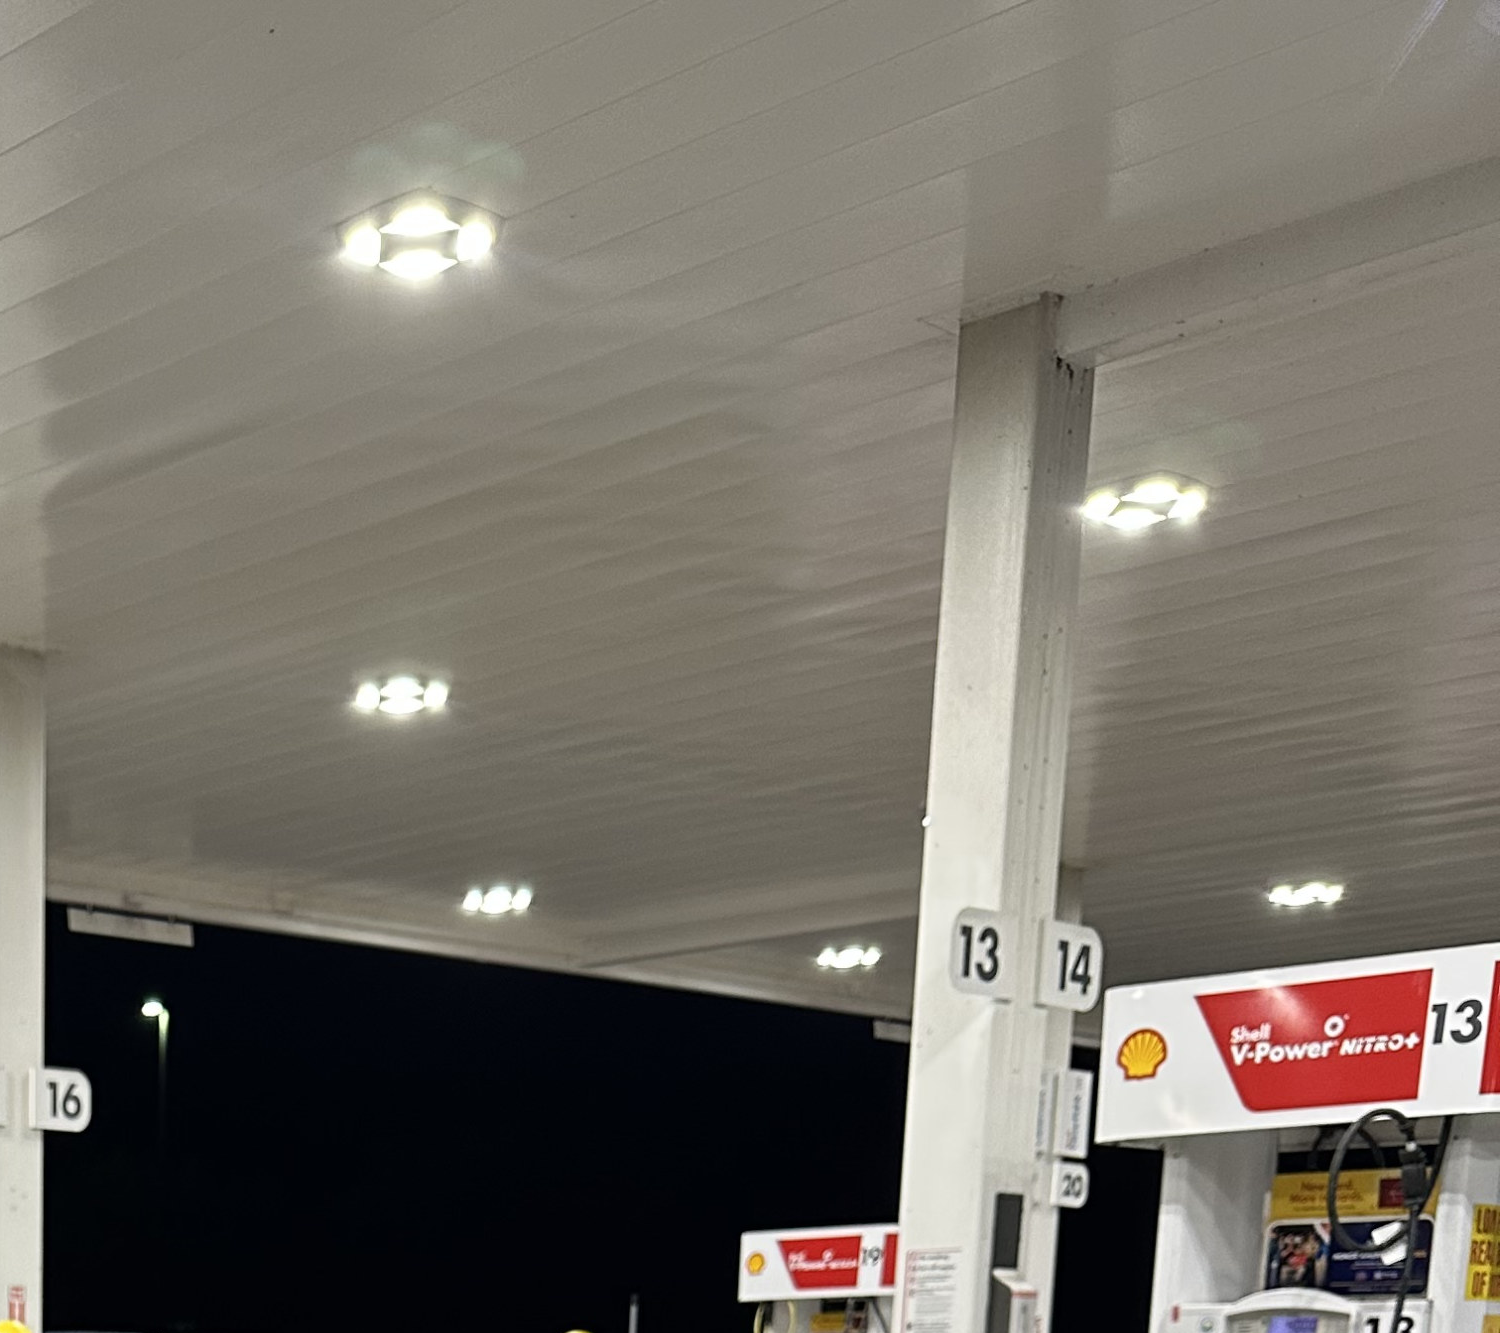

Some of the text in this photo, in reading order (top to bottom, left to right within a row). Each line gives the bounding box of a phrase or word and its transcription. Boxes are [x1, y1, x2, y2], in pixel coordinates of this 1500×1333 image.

[960, 925, 999, 982] 13
[1058, 940, 1092, 995] 14
[1230, 1022, 1272, 1044] Shell
[1431, 999, 1483, 1045] 13
[1230, 1041, 1336, 1066] V-Power
[47, 1081, 81, 1119] 16
[1062, 1173, 1083, 1198] 20
[862, 1245, 882, 1267] 19
